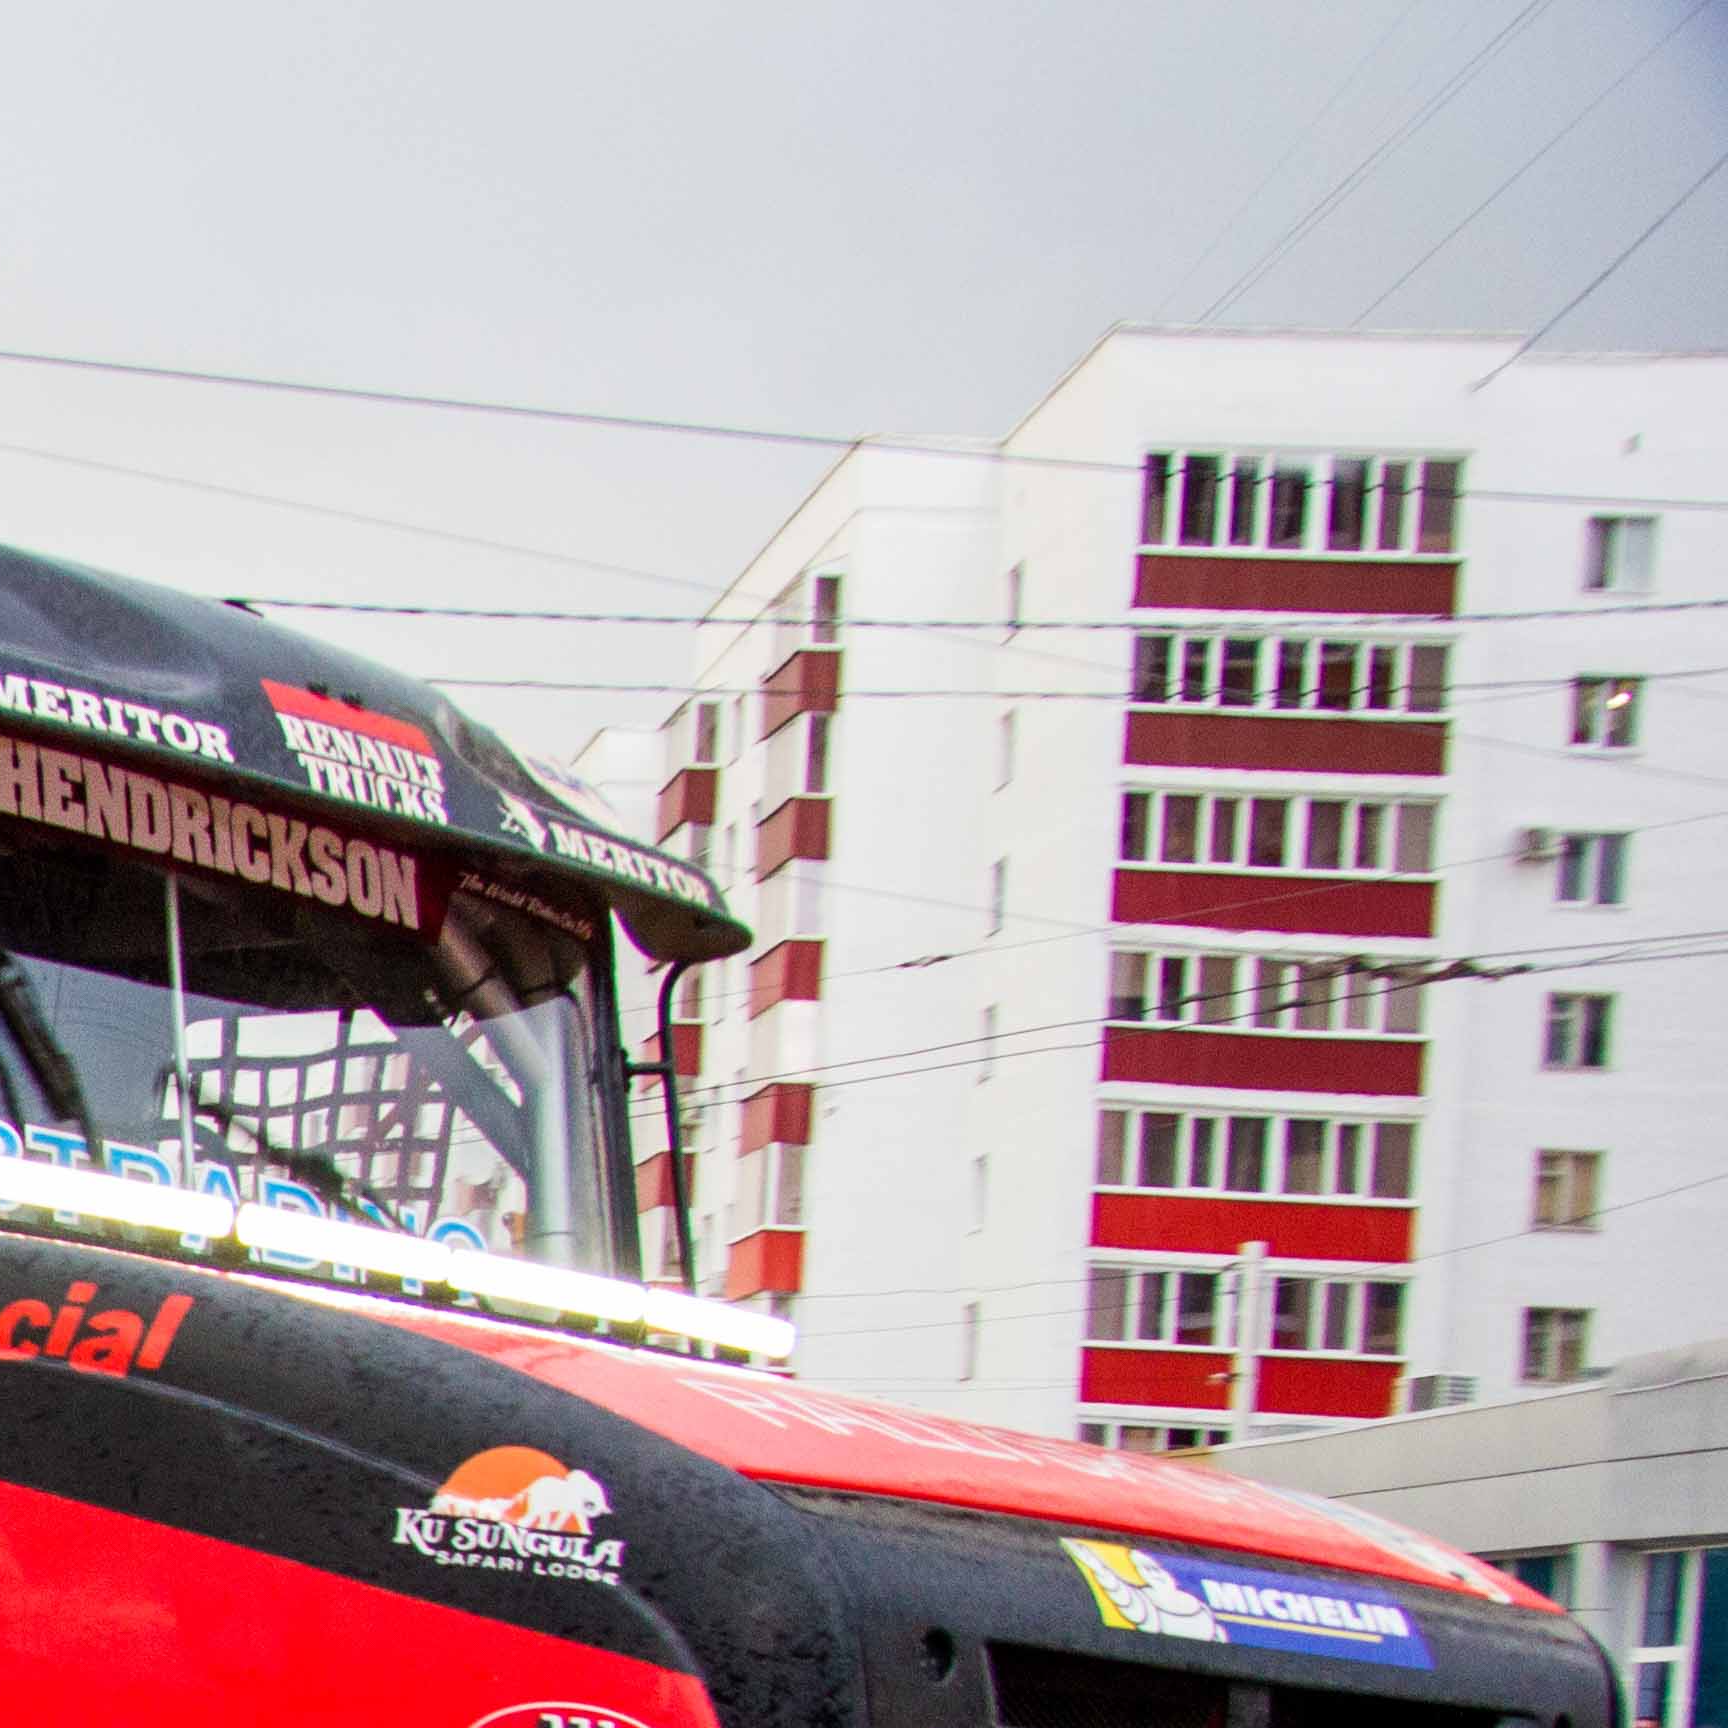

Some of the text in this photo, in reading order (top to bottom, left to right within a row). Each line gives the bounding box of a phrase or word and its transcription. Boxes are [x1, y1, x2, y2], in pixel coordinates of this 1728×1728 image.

[276, 712, 443, 792] RENAULT
[297, 753, 448, 826] TRUCKS
[554, 823, 712, 909] MERITOR
[435, 1550, 621, 1586] SAFARI LODGE
[1201, 1580, 1410, 1638] MICHELIN
